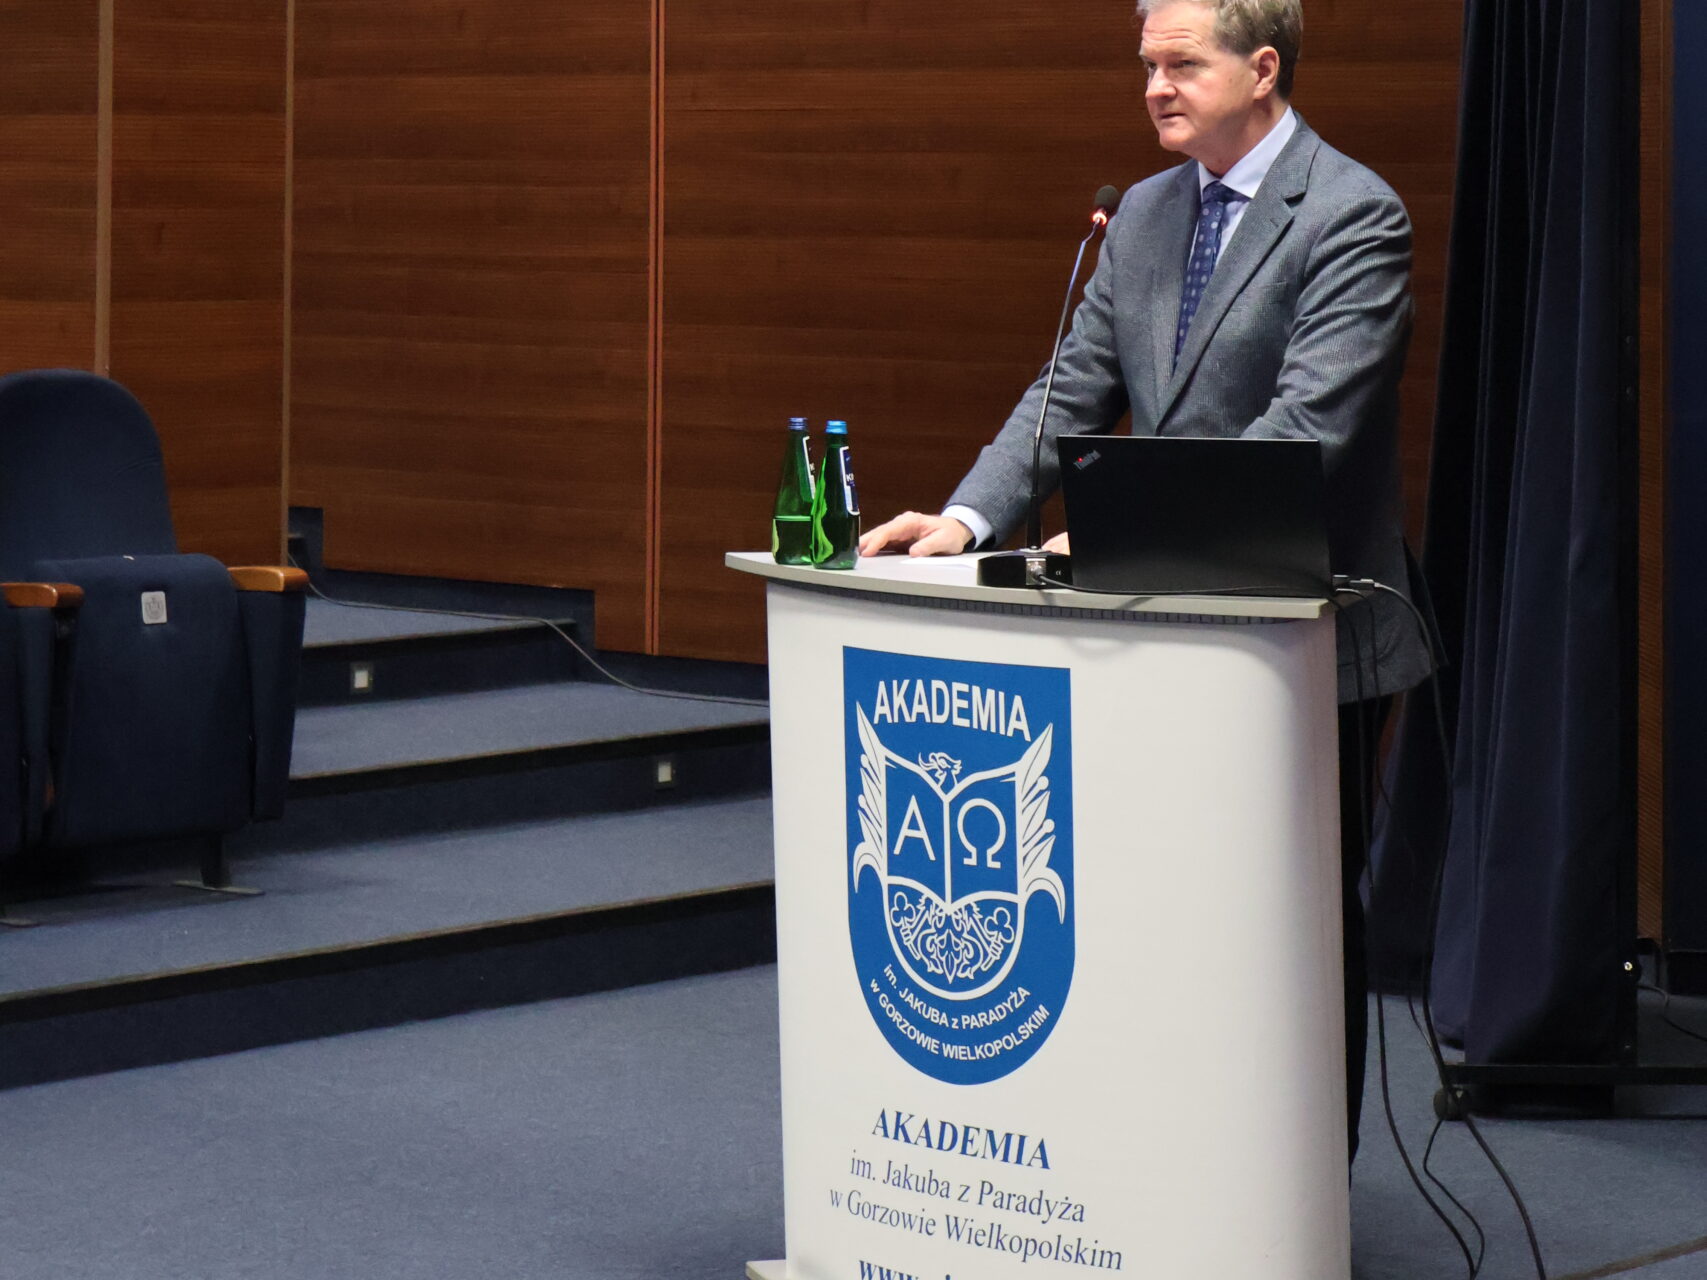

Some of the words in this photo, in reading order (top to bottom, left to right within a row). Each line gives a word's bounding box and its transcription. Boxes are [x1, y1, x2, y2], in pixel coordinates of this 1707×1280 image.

[873, 678, 1031, 742] AKADEMIA
[869, 977, 880, 993] w
[877, 992, 940, 1055] GORZOWIE
[942, 1004, 1051, 1062] WIELKOPOLSKIM
[883, 962, 899, 990] im.
[898, 989, 949, 1028] JAKUBA
[951, 1017, 959, 1029] z
[961, 986, 1032, 1030] PARADYŻA
[871, 1107, 1052, 1170] AKADEMIA
[850, 1149, 876, 1181] im.
[882, 1159, 951, 1200] Jakuba
[958, 1184, 970, 1203] z
[978, 1180, 1085, 1225] Paradyża
[829, 1188, 843, 1208] w
[847, 1189, 937, 1237] Gorzowie
[945, 1213, 1123, 1271] Wielkopolskim
